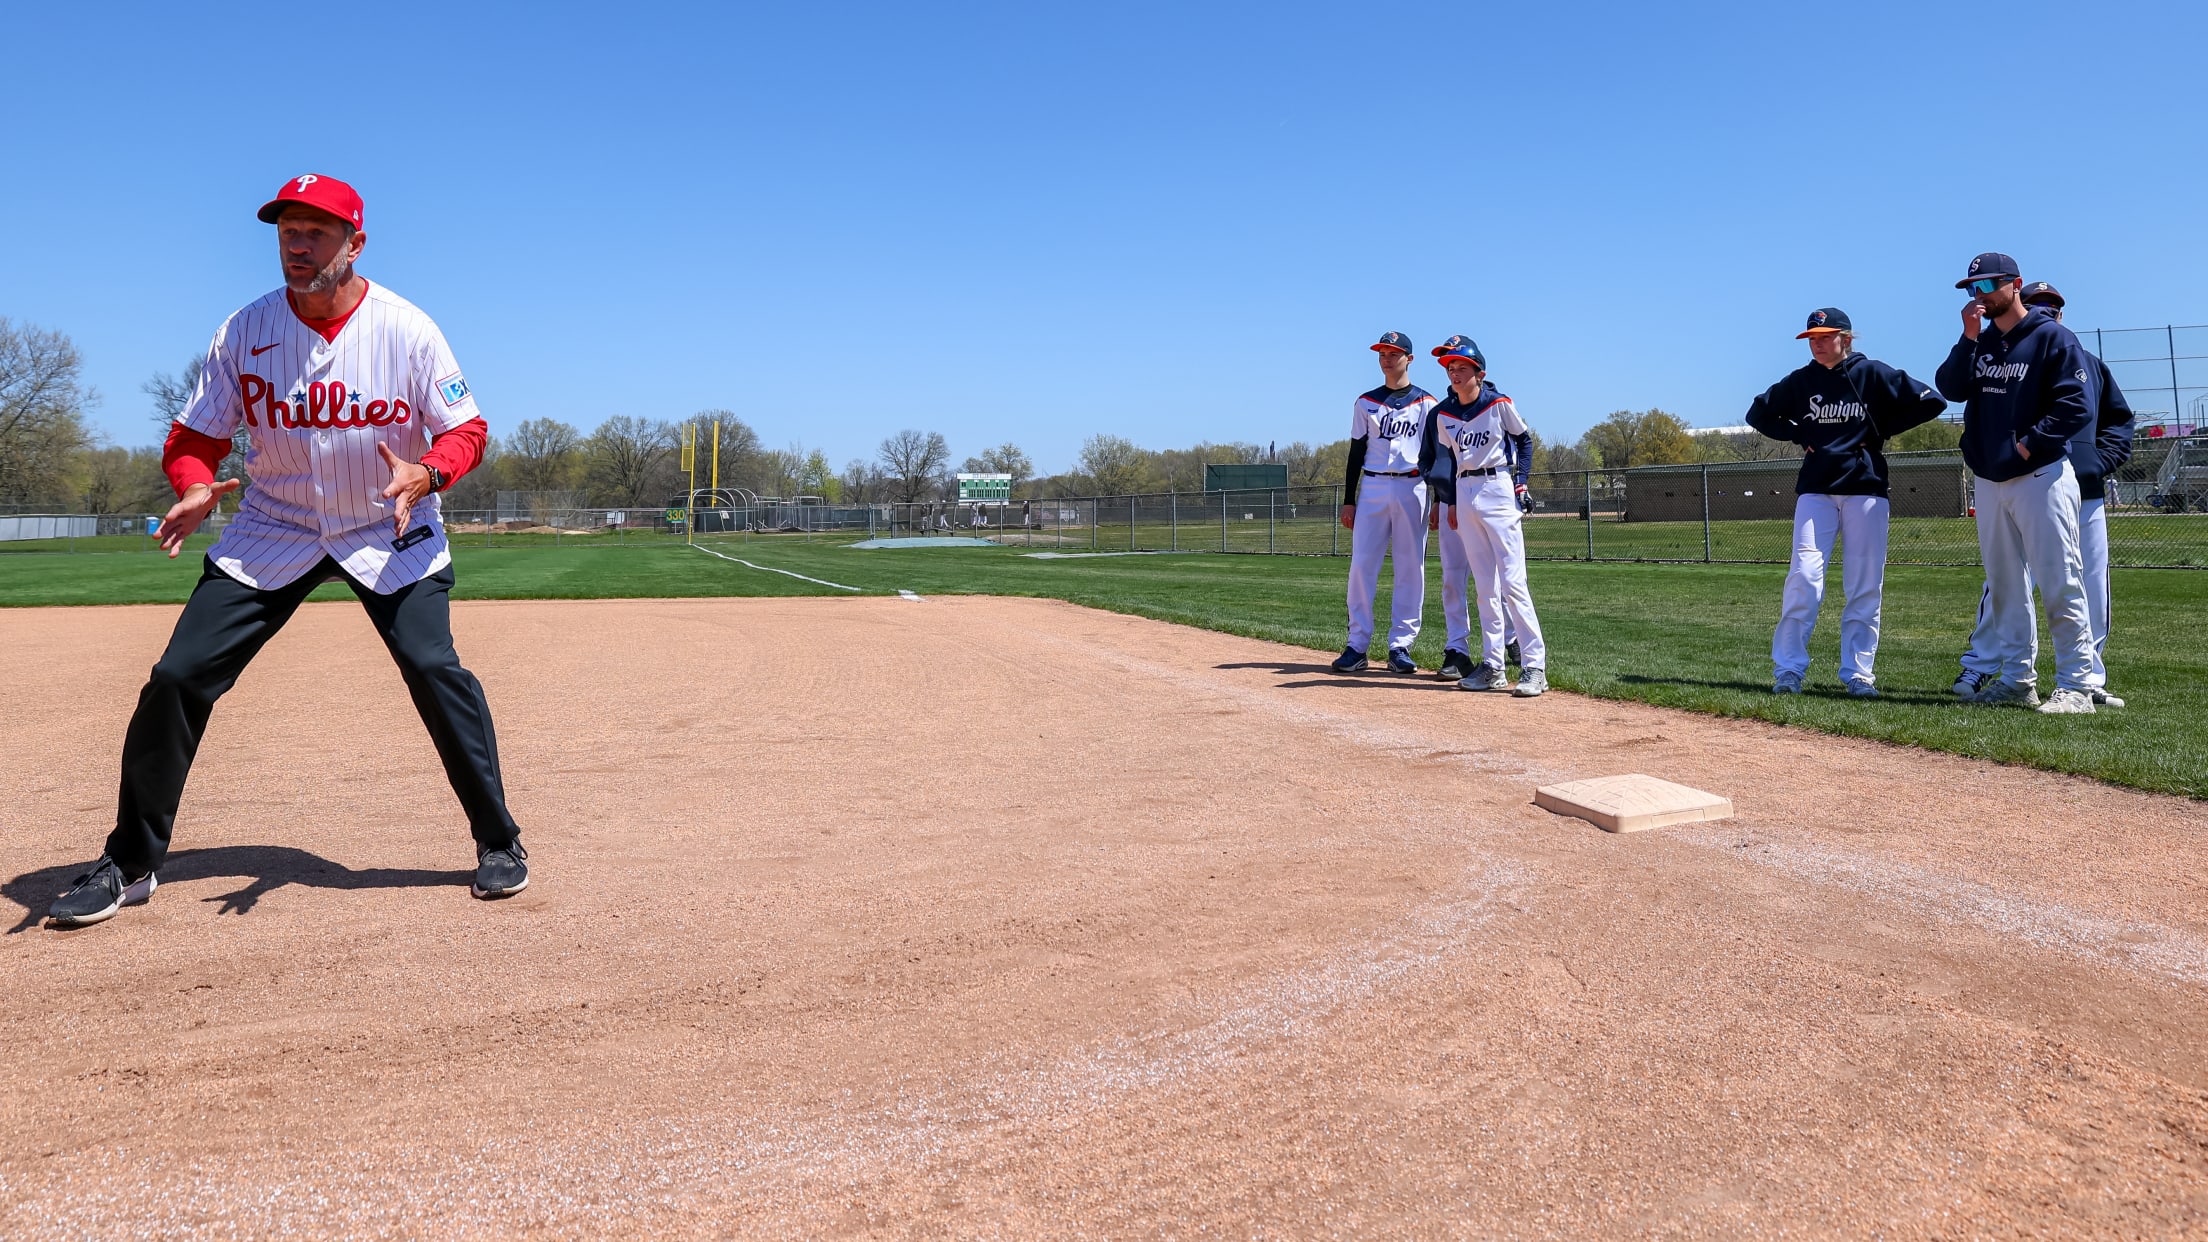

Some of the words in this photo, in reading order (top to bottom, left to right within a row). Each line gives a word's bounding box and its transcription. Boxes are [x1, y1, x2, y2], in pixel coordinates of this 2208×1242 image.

[297, 174, 318, 193] P
[1970, 258, 1981, 273] S
[2034, 282, 2048, 291] S
[1975, 353, 2029, 384] Savigny
[240, 374, 411, 429] Phillies
[1803, 394, 1868, 422] Savigny
[1379, 412, 1419, 442] Lions
[666, 509, 685, 521] 330
